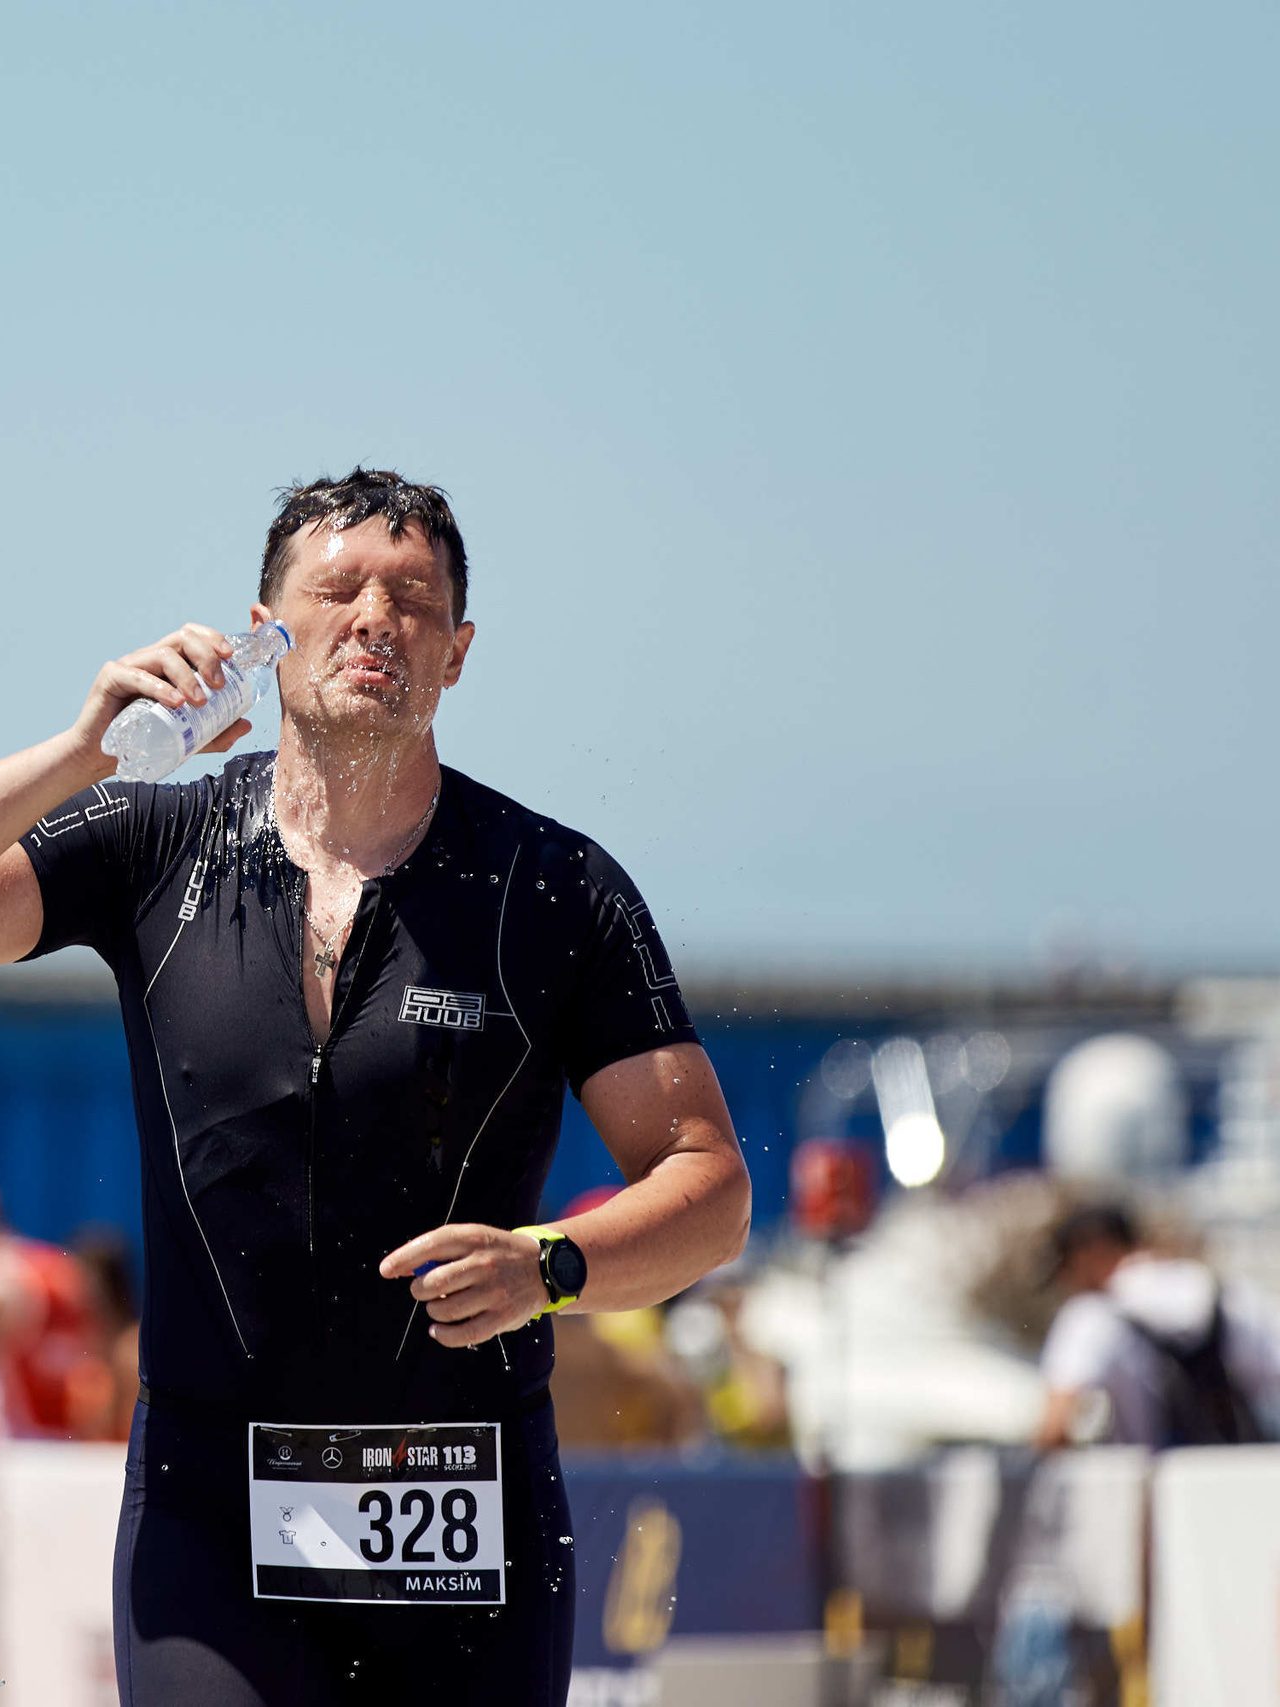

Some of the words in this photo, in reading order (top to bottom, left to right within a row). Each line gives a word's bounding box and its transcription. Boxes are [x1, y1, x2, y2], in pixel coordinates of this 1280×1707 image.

[401, 1004, 480, 1028] HUUB
[363, 1447, 392, 1467] IRON
[407, 1446, 438, 1466] STAR
[442, 1445, 476, 1465] 113
[358, 1488, 478, 1563] 328
[406, 1577, 481, 1591] MAKSIM
